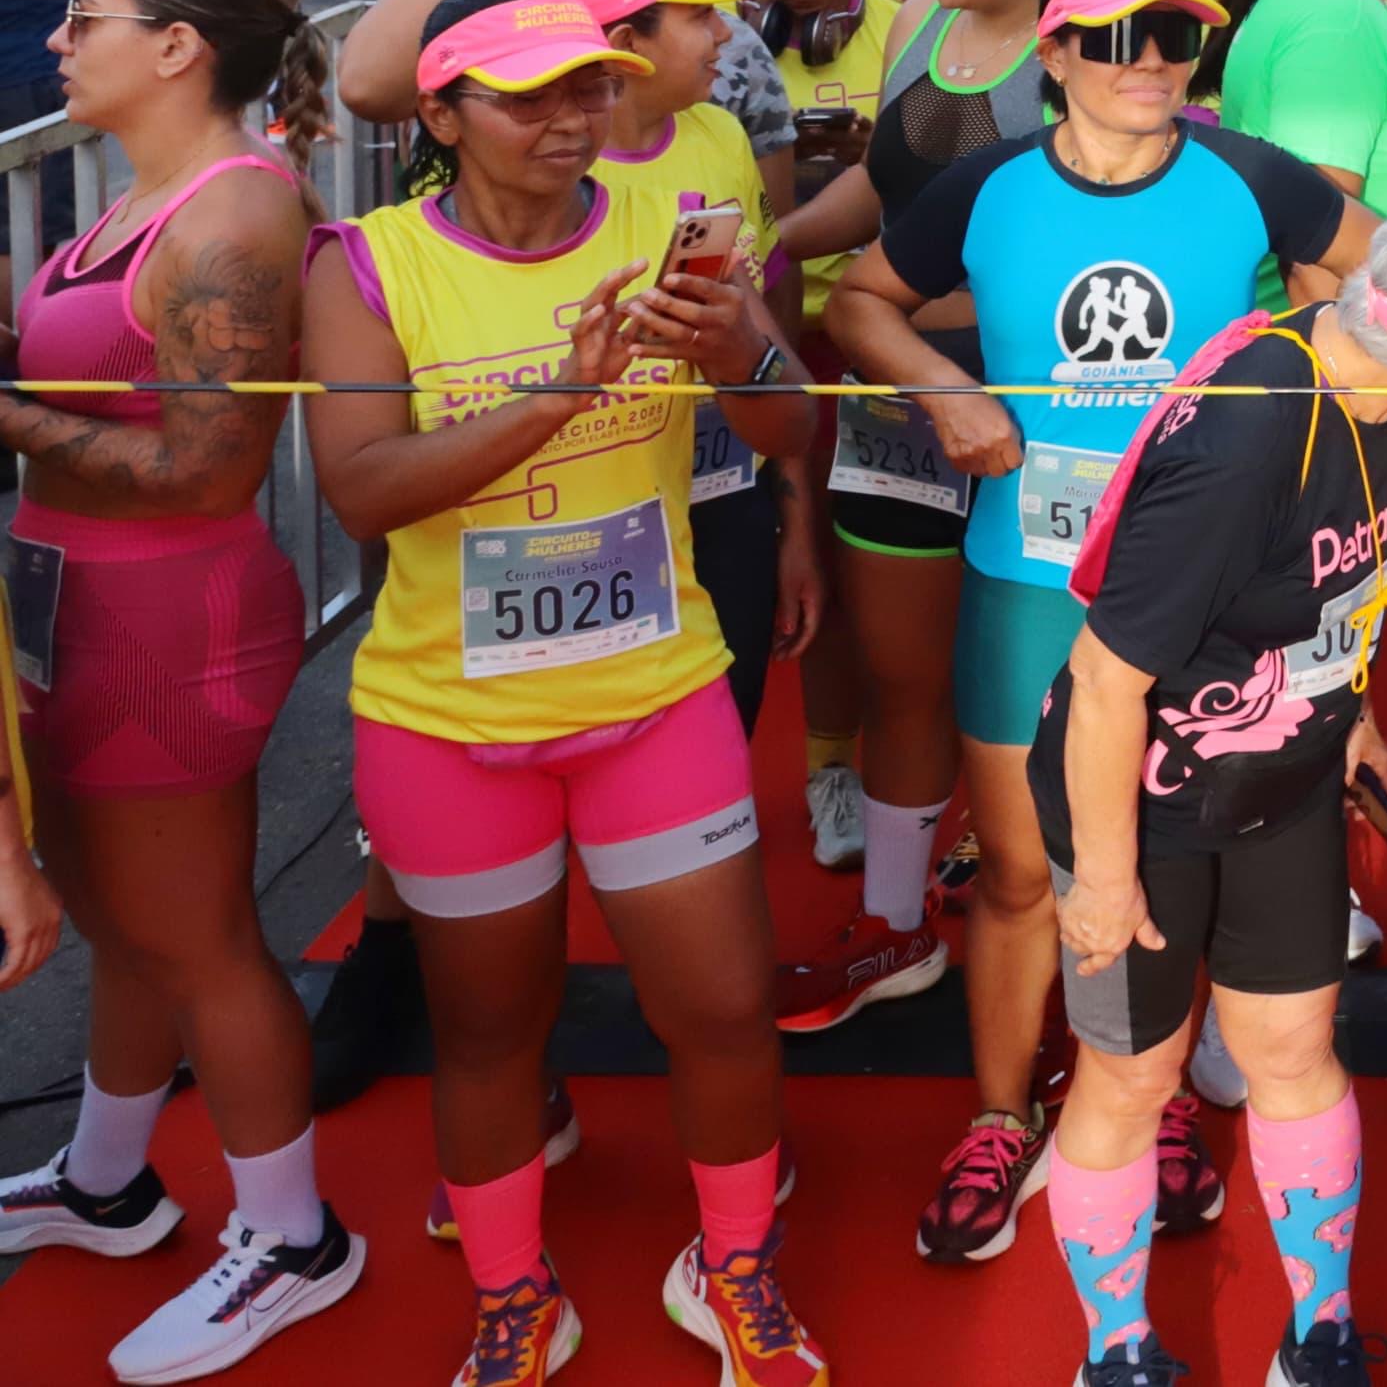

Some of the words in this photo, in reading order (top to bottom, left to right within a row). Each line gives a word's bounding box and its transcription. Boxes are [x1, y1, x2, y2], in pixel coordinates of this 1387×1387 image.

[1081, 364, 1145, 379] GOIÂNIA
[854, 430, 939, 482] 5234
[524, 538, 602, 558] MULHERES
[526, 530, 591, 548] CIRCUITO
[582, 556, 623, 575] Sousa
[495, 570, 635, 641] 5026
